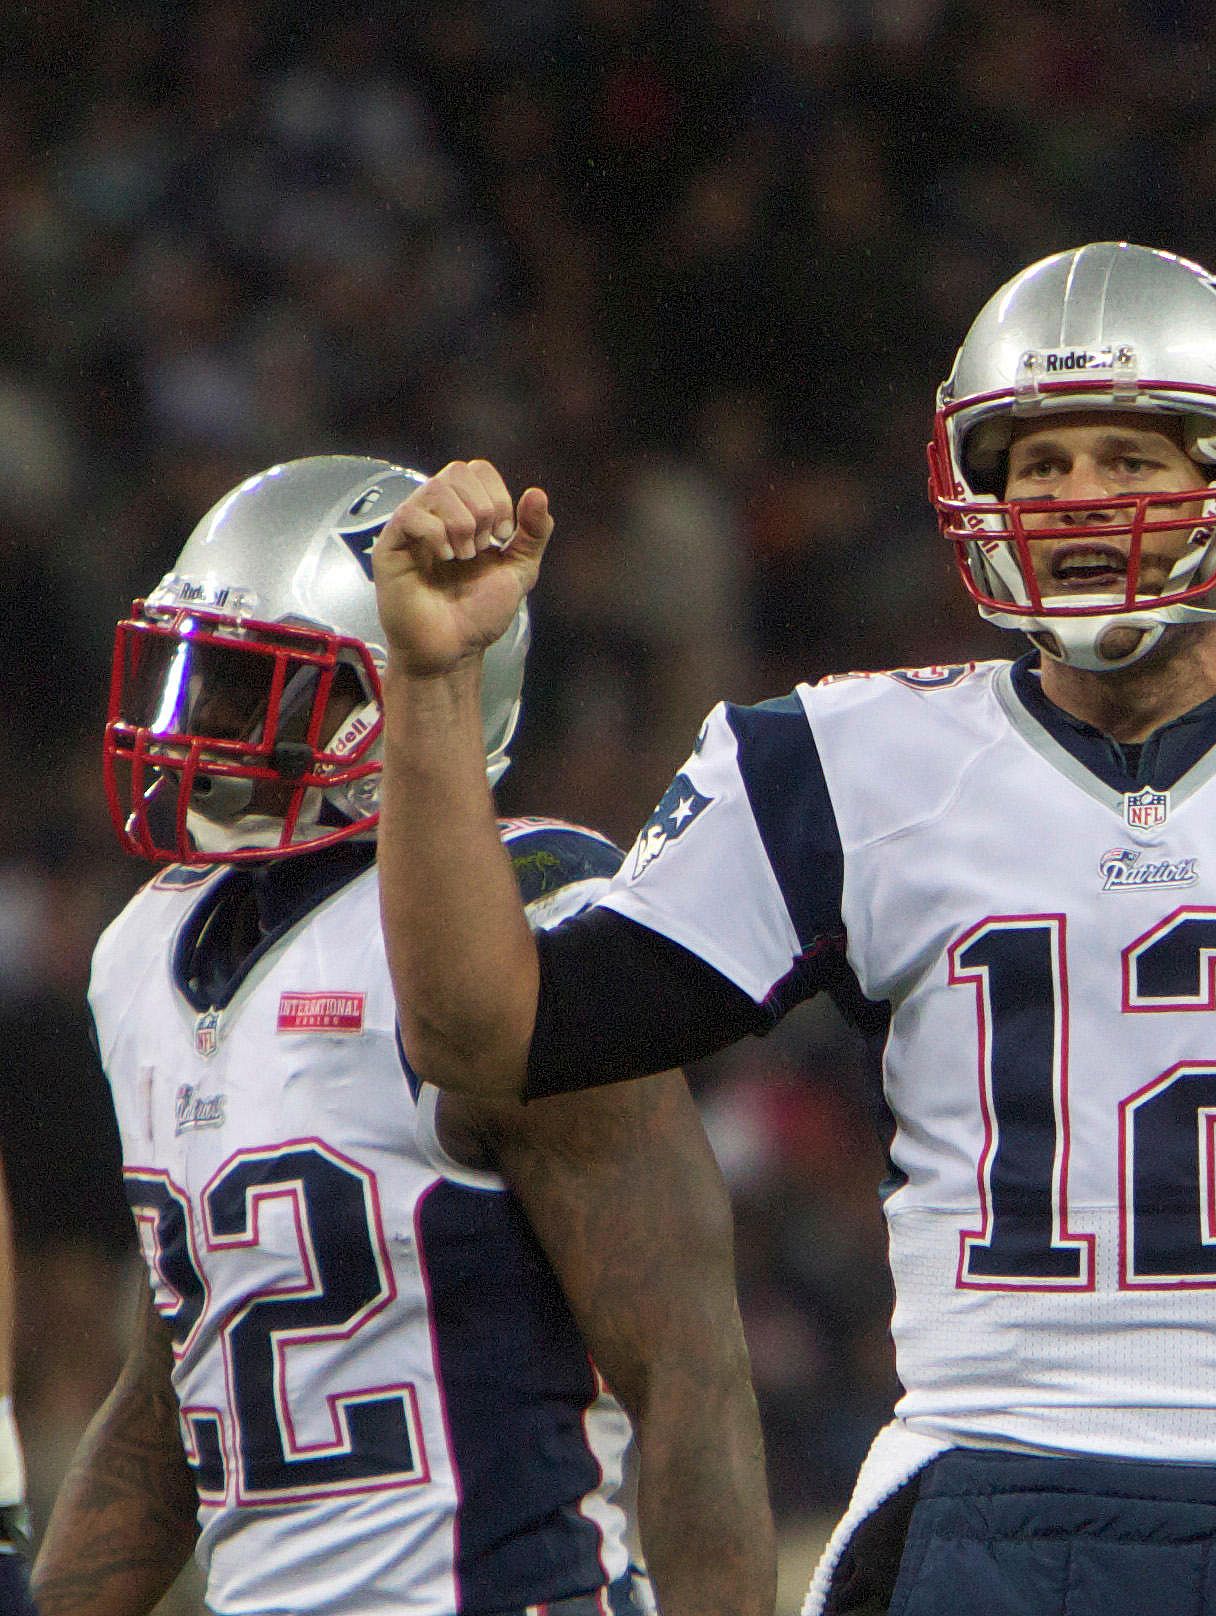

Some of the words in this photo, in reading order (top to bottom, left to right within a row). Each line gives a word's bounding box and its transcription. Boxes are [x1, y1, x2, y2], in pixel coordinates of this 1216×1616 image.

[1046, 346, 1113, 371] Ridd
[1131, 806, 1163, 826] NFL
[1101, 857, 1199, 891] Patriots
